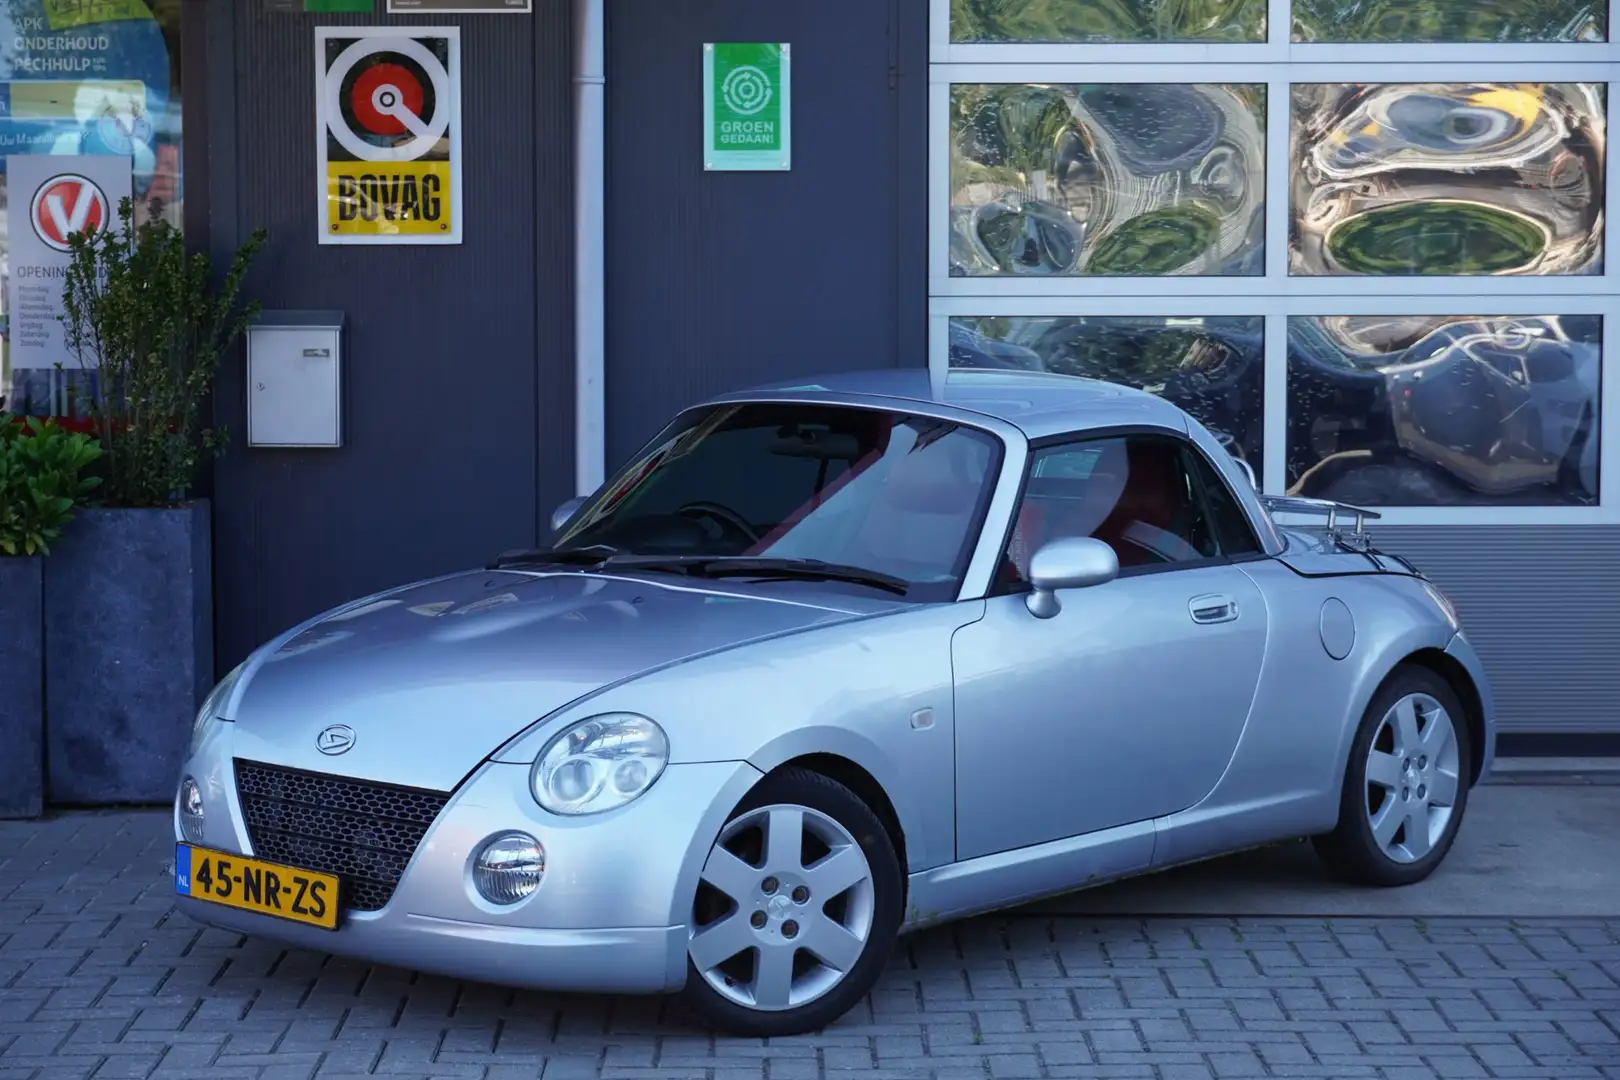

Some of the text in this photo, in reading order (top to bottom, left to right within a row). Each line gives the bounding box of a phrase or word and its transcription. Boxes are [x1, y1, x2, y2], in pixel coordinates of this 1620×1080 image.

[14, 17, 43, 31] APK
[14, 37, 109, 50] ONDERHOUD
[14, 58, 91, 71] PECHHULP
[721, 121, 774, 133] GROEN
[338, 174, 440, 221] BOVAG
[178, 875, 189, 888] NL
[196, 858, 327, 918] 45-NR-ZS
